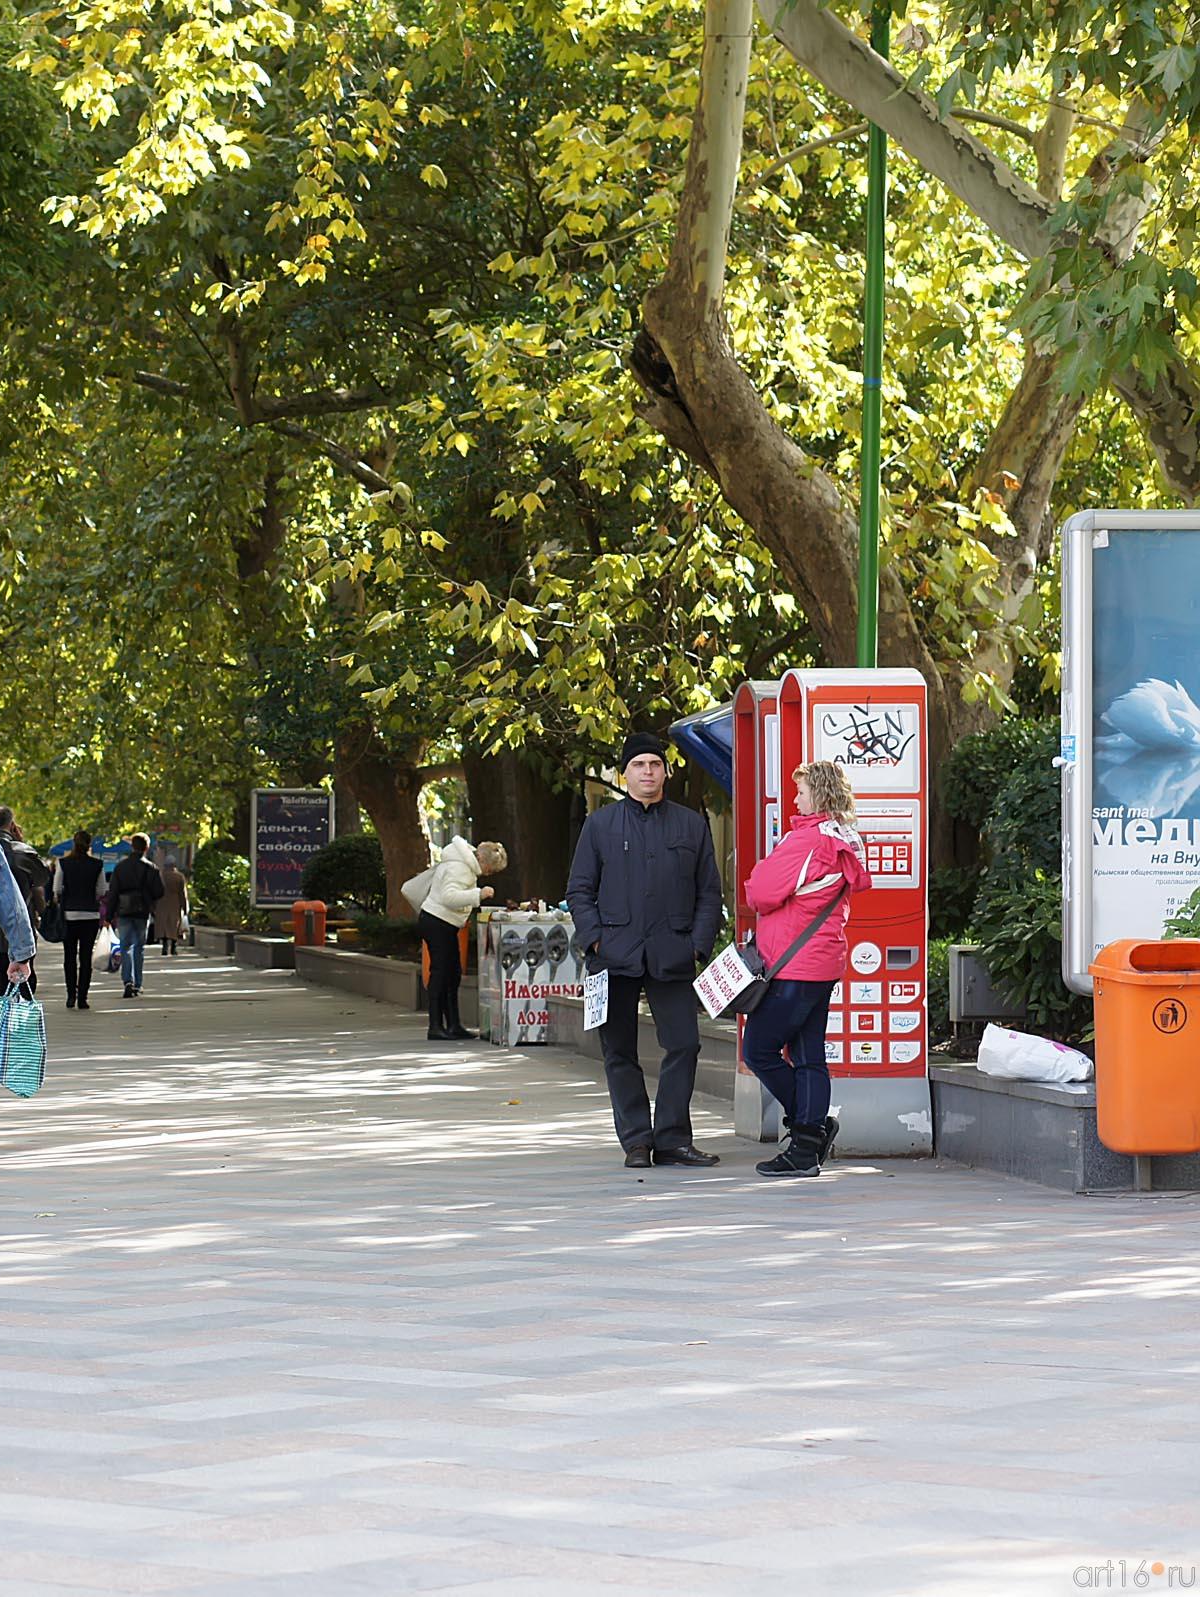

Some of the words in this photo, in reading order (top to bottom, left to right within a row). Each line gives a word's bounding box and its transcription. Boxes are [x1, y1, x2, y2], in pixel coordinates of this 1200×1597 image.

[281, 796, 328, 805] TeleTrade
[1092, 805, 1124, 818] sant
[1127, 805, 1155, 818] mat
[258, 825, 311, 833] деньги.
[1151, 853, 1169, 864] на
[258, 860, 305, 872] будущ
[1093, 868, 1129, 876] Крымская
[1130, 868, 1184, 876] общественная
[1167, 897, 1175, 905] 18
[1165, 908, 1174, 916] 19
[517, 1010, 549, 1025] лож
